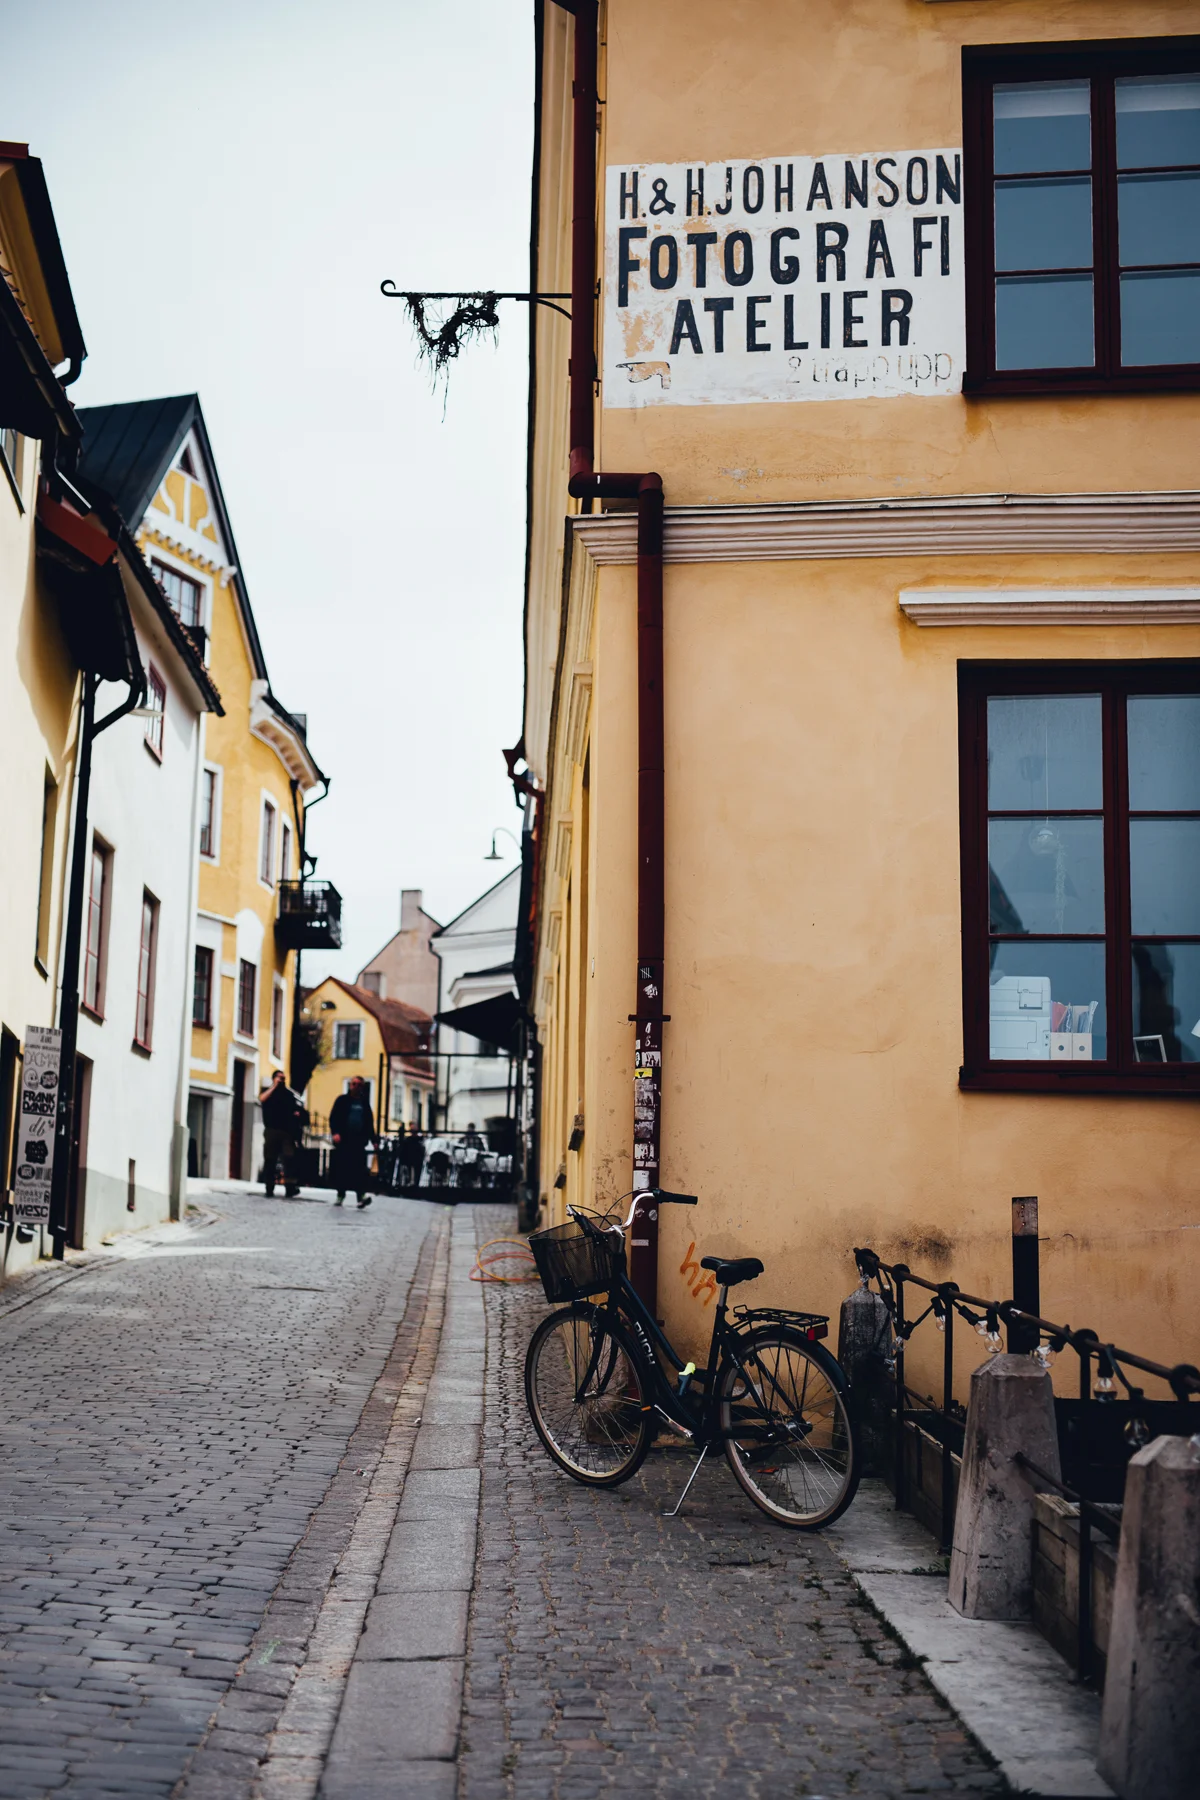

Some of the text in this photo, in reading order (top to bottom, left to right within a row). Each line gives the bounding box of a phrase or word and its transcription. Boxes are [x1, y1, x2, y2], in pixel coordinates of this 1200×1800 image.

[618, 215, 950, 307] FOTOGRAFI
[669, 288, 914, 354] ATELIER
[897, 352, 953, 388] upp
[22, 1101, 54, 1114] DANDY
[23, 1090, 55, 1104] FRANK
[633, 1321, 656, 1365] PUCH
